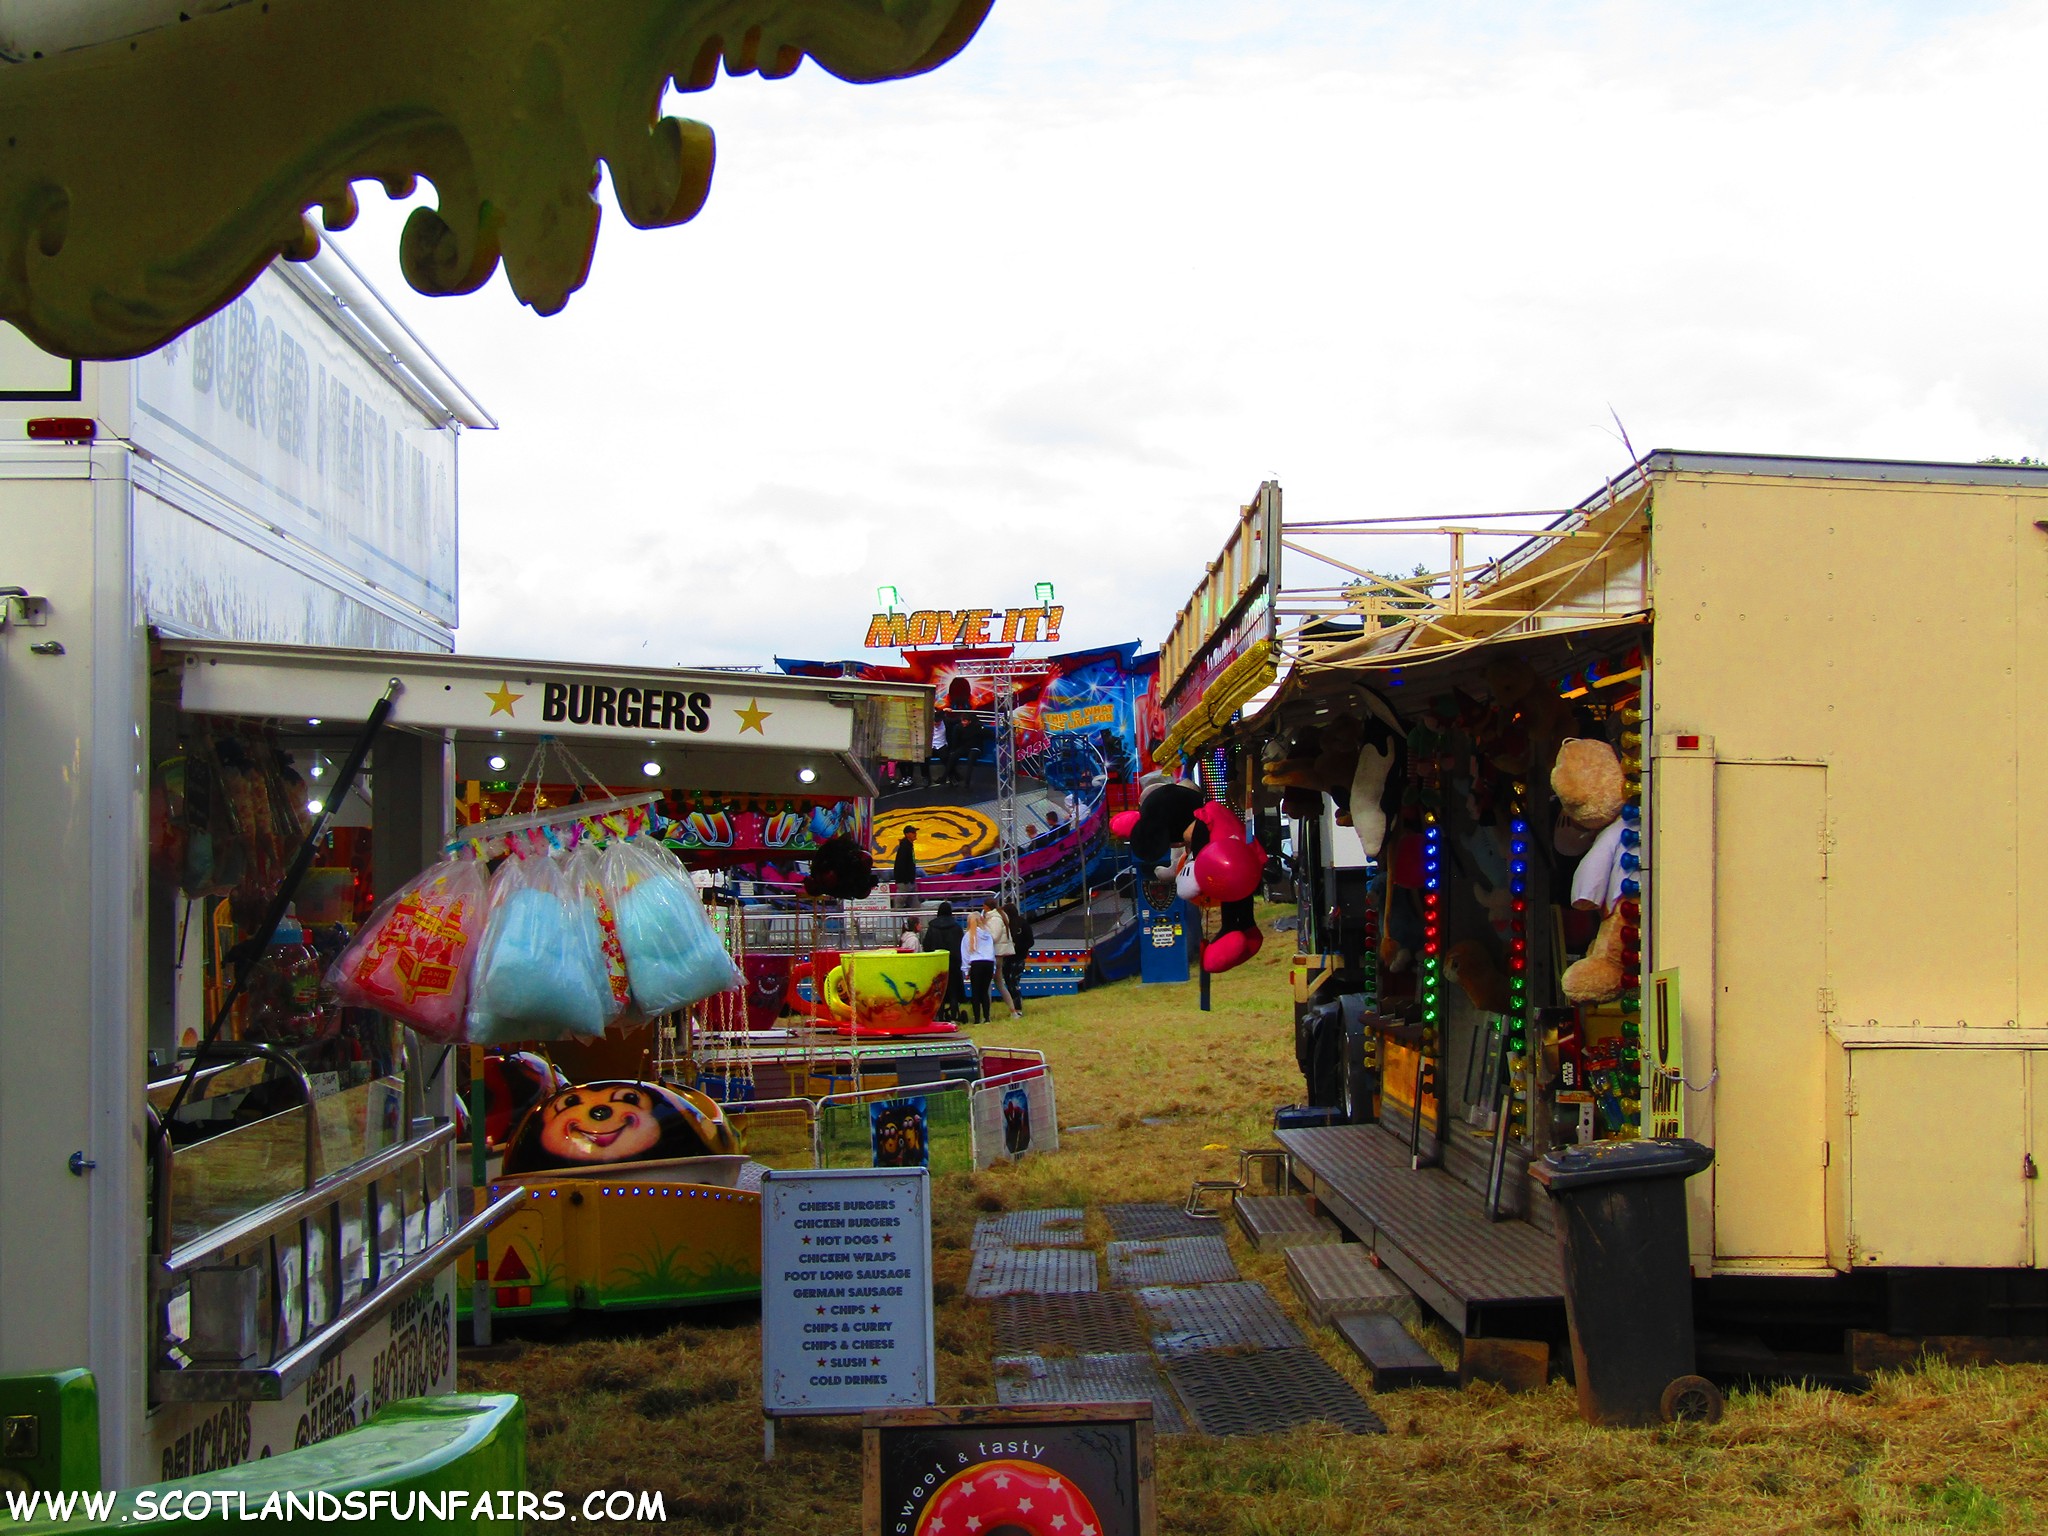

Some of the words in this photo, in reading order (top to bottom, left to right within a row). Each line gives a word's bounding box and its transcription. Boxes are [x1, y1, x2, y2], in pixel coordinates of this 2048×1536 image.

[864, 609, 993, 647] MOVE
[1002, 605, 1065, 643] IT!
[542, 682, 711, 733] BURGERS
[1045, 713, 1068, 723] THIS
[1070, 710, 1081, 719] IS
[1084, 704, 1115, 716] WHAT
[1067, 717, 1091, 730] LIVE
[1093, 713, 1113, 723] FOR
[421, 969, 450, 978] CANDY
[1655, 978, 1669, 1068] U
[1566, 1062, 1574, 1085] WARS
[798, 1201, 841, 1212] CHEESE
[843, 1200, 896, 1211] BURGERS
[794, 1218, 845, 1229] CHICKEN
[848, 1217, 901, 1228] BURGERS
[816, 1235, 842, 1246] HOT
[844, 1235, 879, 1245] DOGS
[798, 1252, 850, 1263] CHICKEN
[853, 1252, 896, 1262] WRAPS
[784, 1270, 817, 1281] FOOT
[820, 1270, 853, 1280] LONG
[856, 1269, 911, 1279] SAUSAGE
[793, 1288, 845, 1299] GERMAN
[848, 1286, 903, 1297] SAUSAGE
[830, 1305, 865, 1315] CHIPS
[803, 1323, 838, 1333] CHIPS
[841, 1322, 850, 1333] &
[853, 1322, 893, 1332] CURRY
[802, 1340, 837, 1351] CHIPS
[840, 1340, 849, 1350] &
[851, 1339, 895, 1350] CHEESE
[372, 1293, 450, 1413] HOTDOGS
[830, 1357, 867, 1368] SLUSH
[809, 1375, 842, 1386] COLD
[844, 1374, 888, 1385] DRINKS
[896, 1461, 947, 1535] sweet
[958, 1451, 969, 1463] &
[978, 1439, 1046, 1460] tasty
